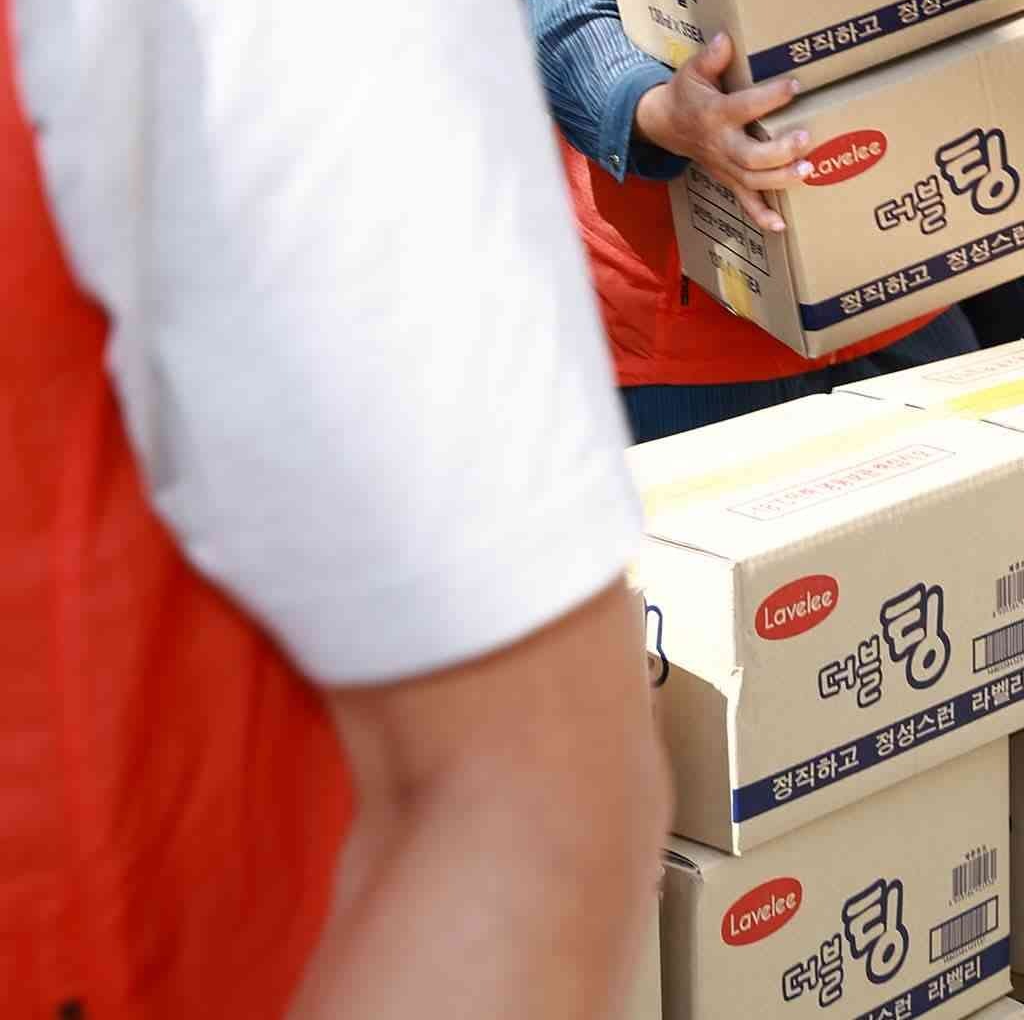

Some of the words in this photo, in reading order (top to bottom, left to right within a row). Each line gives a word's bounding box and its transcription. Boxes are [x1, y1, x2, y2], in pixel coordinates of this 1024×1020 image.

[788, 15, 883, 63] 정직하고
[840, 265, 931, 314] 정직하고
[764, 590, 833, 629] Lavelee
[772, 746, 859, 801] 정직하고
[875, 702, 955, 757] 정성스런
[730, 892, 798, 936] Lavelee
[928, 955, 981, 1001] 라벨리
